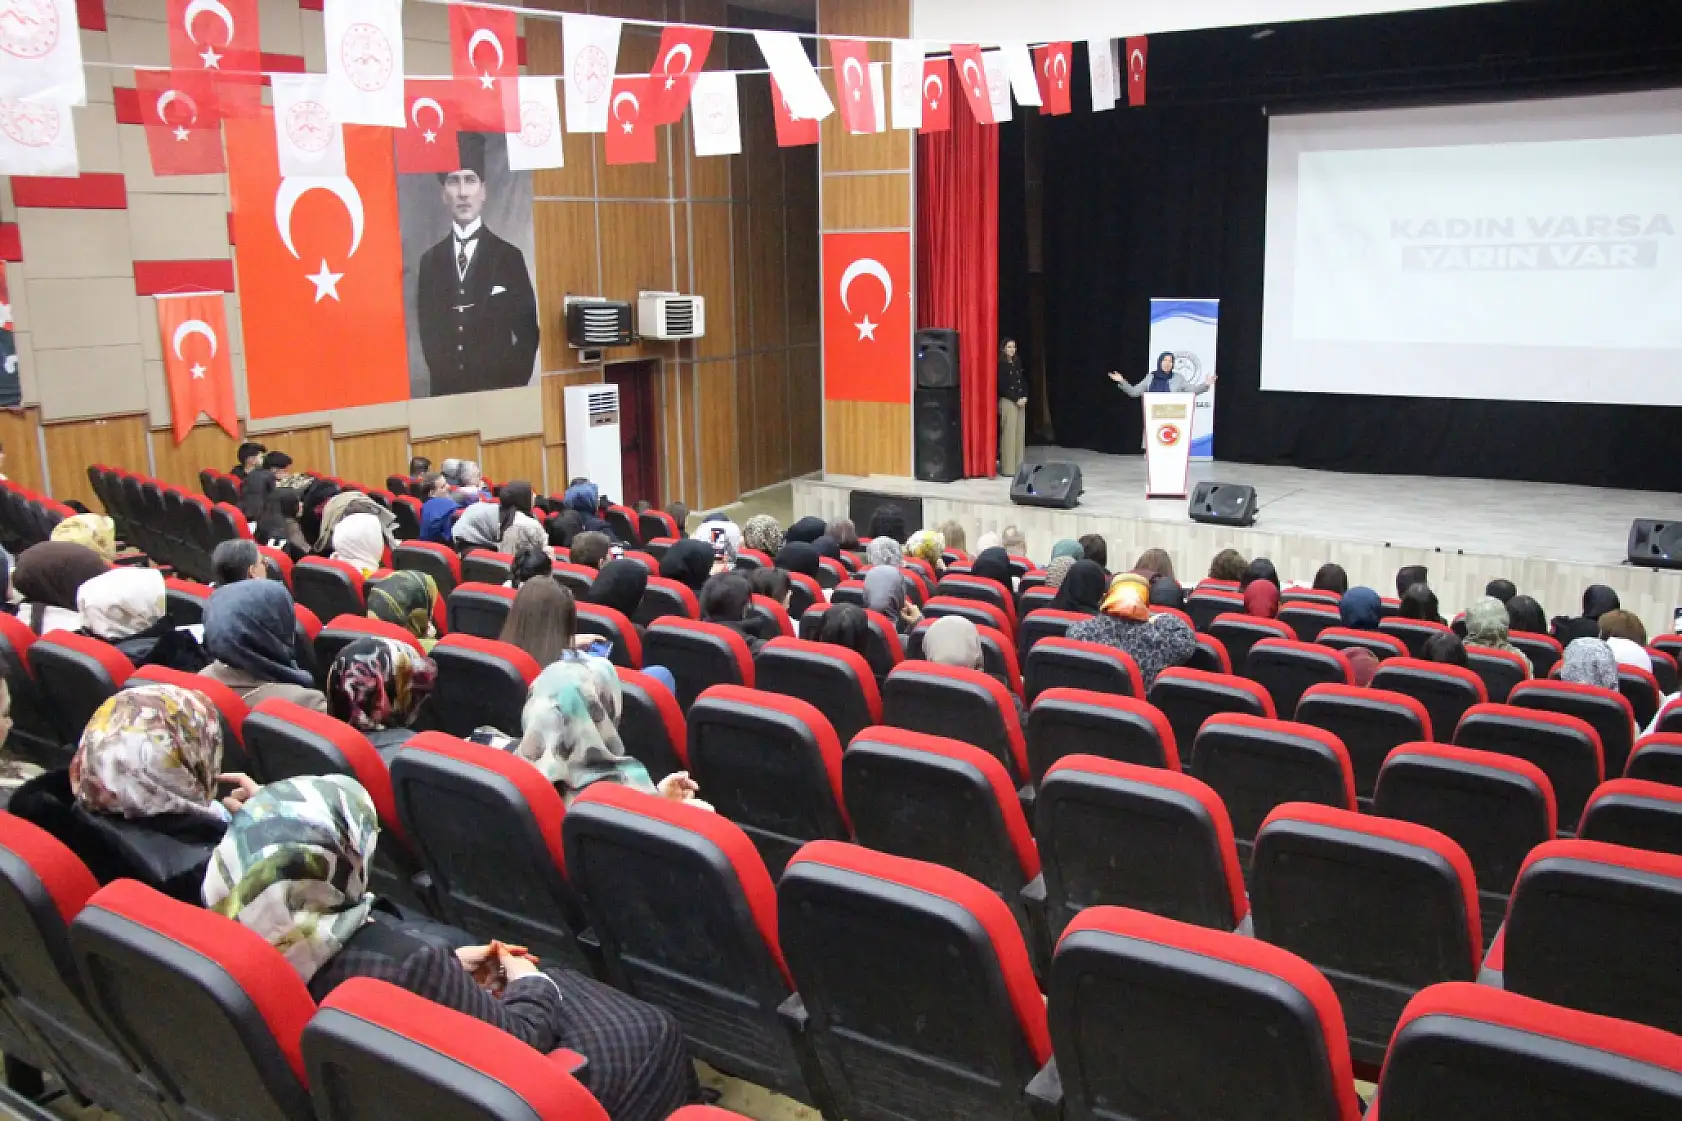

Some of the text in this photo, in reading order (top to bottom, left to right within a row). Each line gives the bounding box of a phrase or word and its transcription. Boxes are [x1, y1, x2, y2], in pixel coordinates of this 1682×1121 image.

[1390, 213, 1675, 240] KADIN VARSA
[1418, 244, 1638, 270] YARIN VAR
